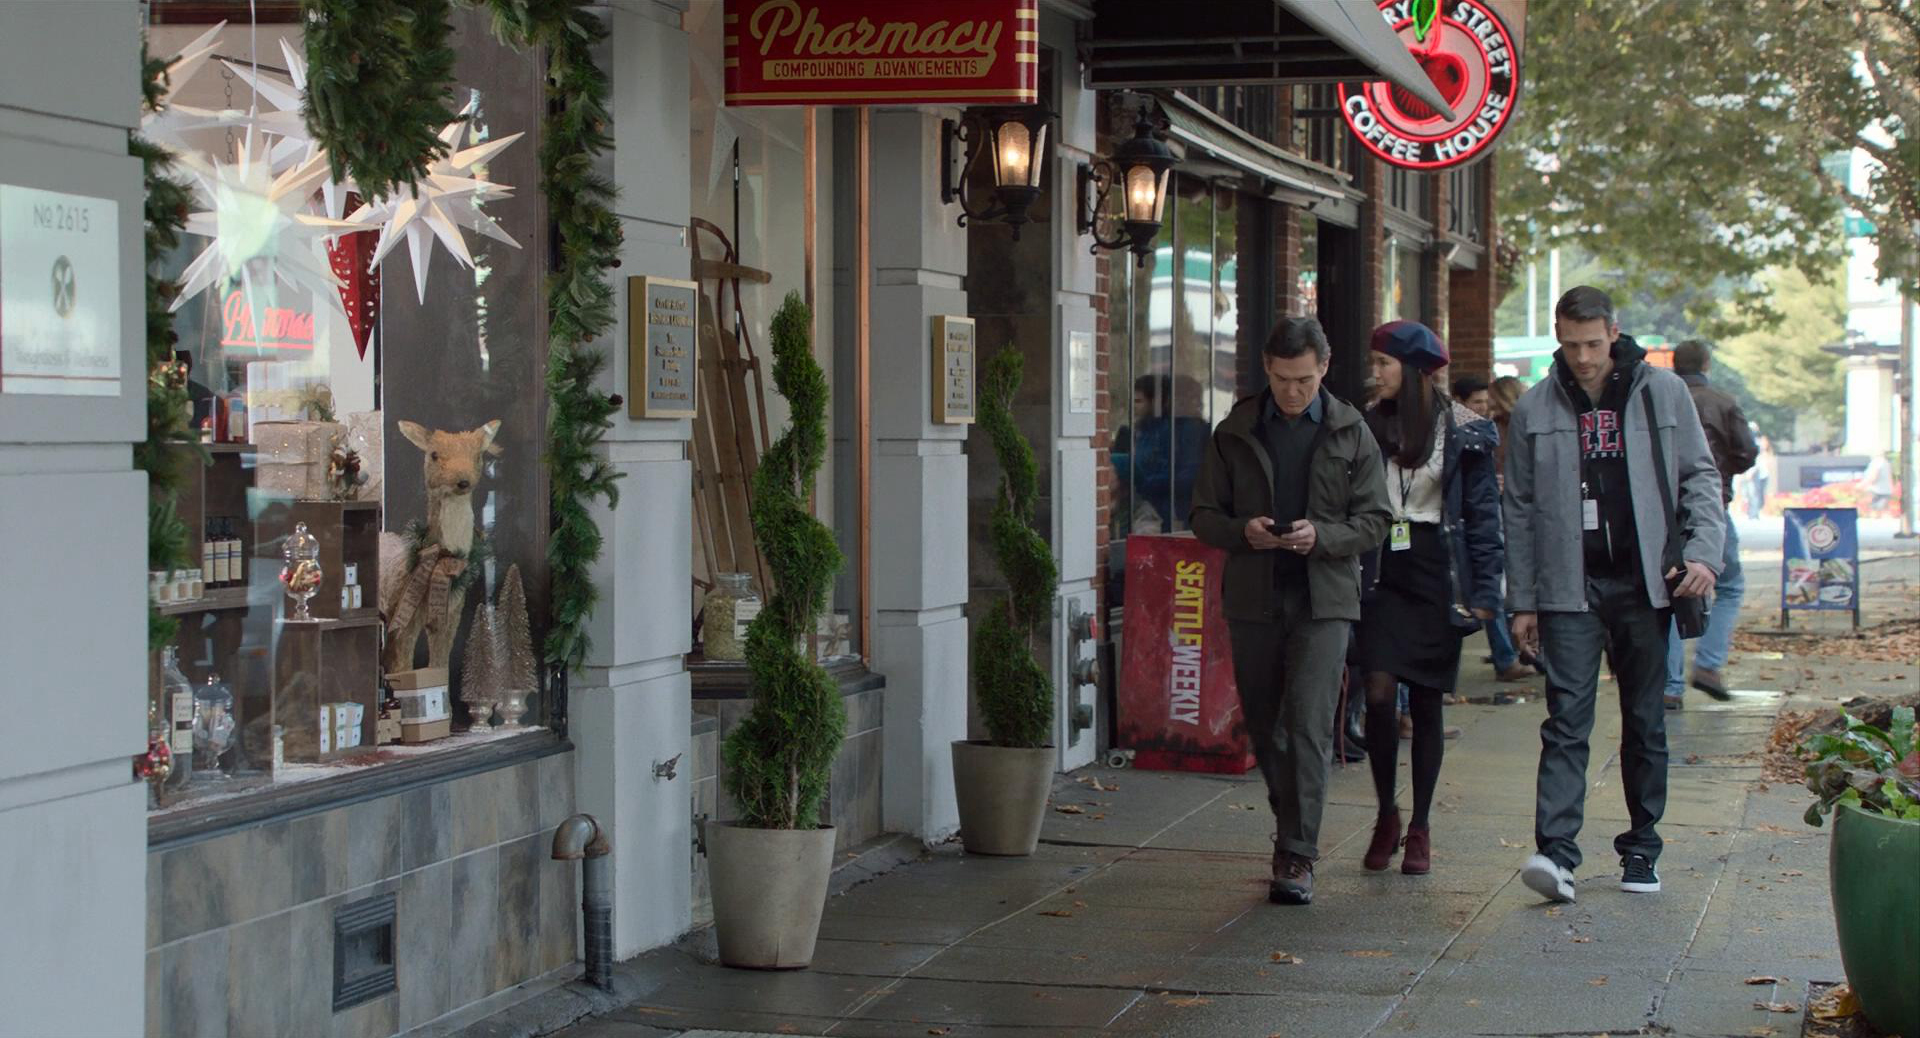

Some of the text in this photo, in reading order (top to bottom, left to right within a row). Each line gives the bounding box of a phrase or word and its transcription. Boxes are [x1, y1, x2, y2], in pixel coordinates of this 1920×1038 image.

[750, 0, 1003, 56] Pharmacy
[1453, 2, 1512, 77] STREET
[774, 60, 978, 77] COMPOUNDING ADVANCEMENTS
[1345, 92, 1509, 162] COFFEE HOUSE
[56, 204, 90, 234] 2615
[1170, 559, 1206, 726] SEATTLE WEEKLY
